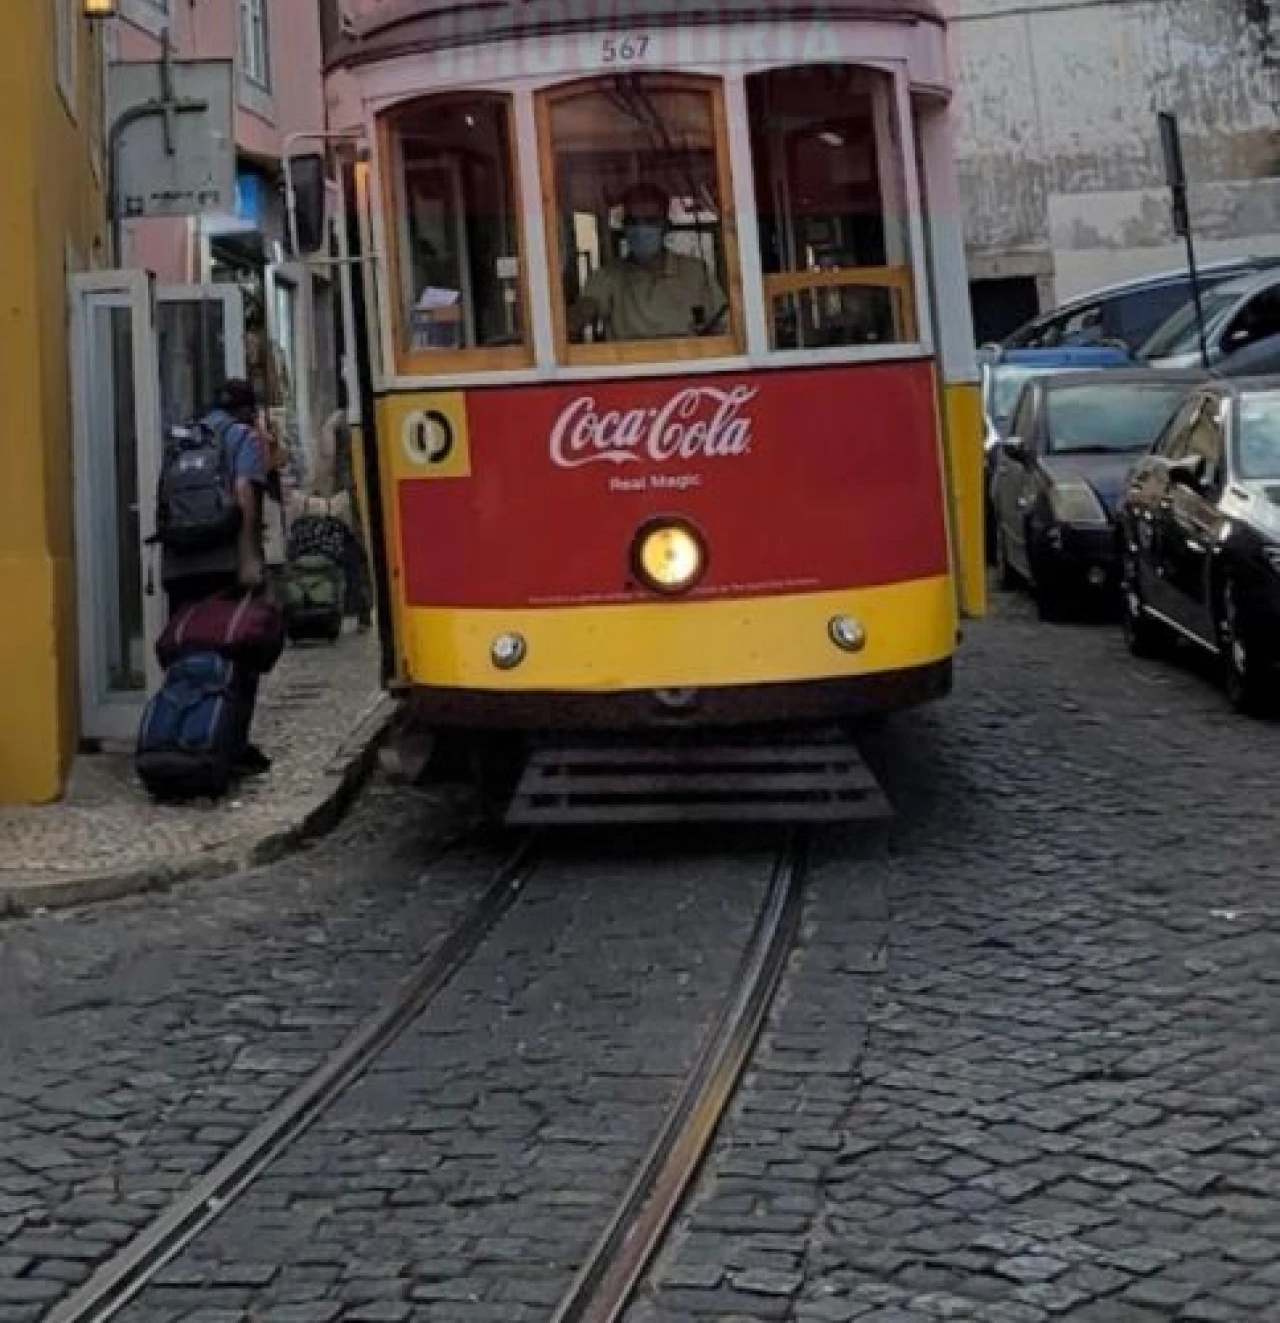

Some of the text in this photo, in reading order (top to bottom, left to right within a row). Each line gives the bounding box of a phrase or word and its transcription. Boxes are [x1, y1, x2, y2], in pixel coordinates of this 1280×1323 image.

[601, 35, 651, 63] 567
[549, 384, 758, 467] Coca-Cola
[609, 473, 702, 491] Real Magic
